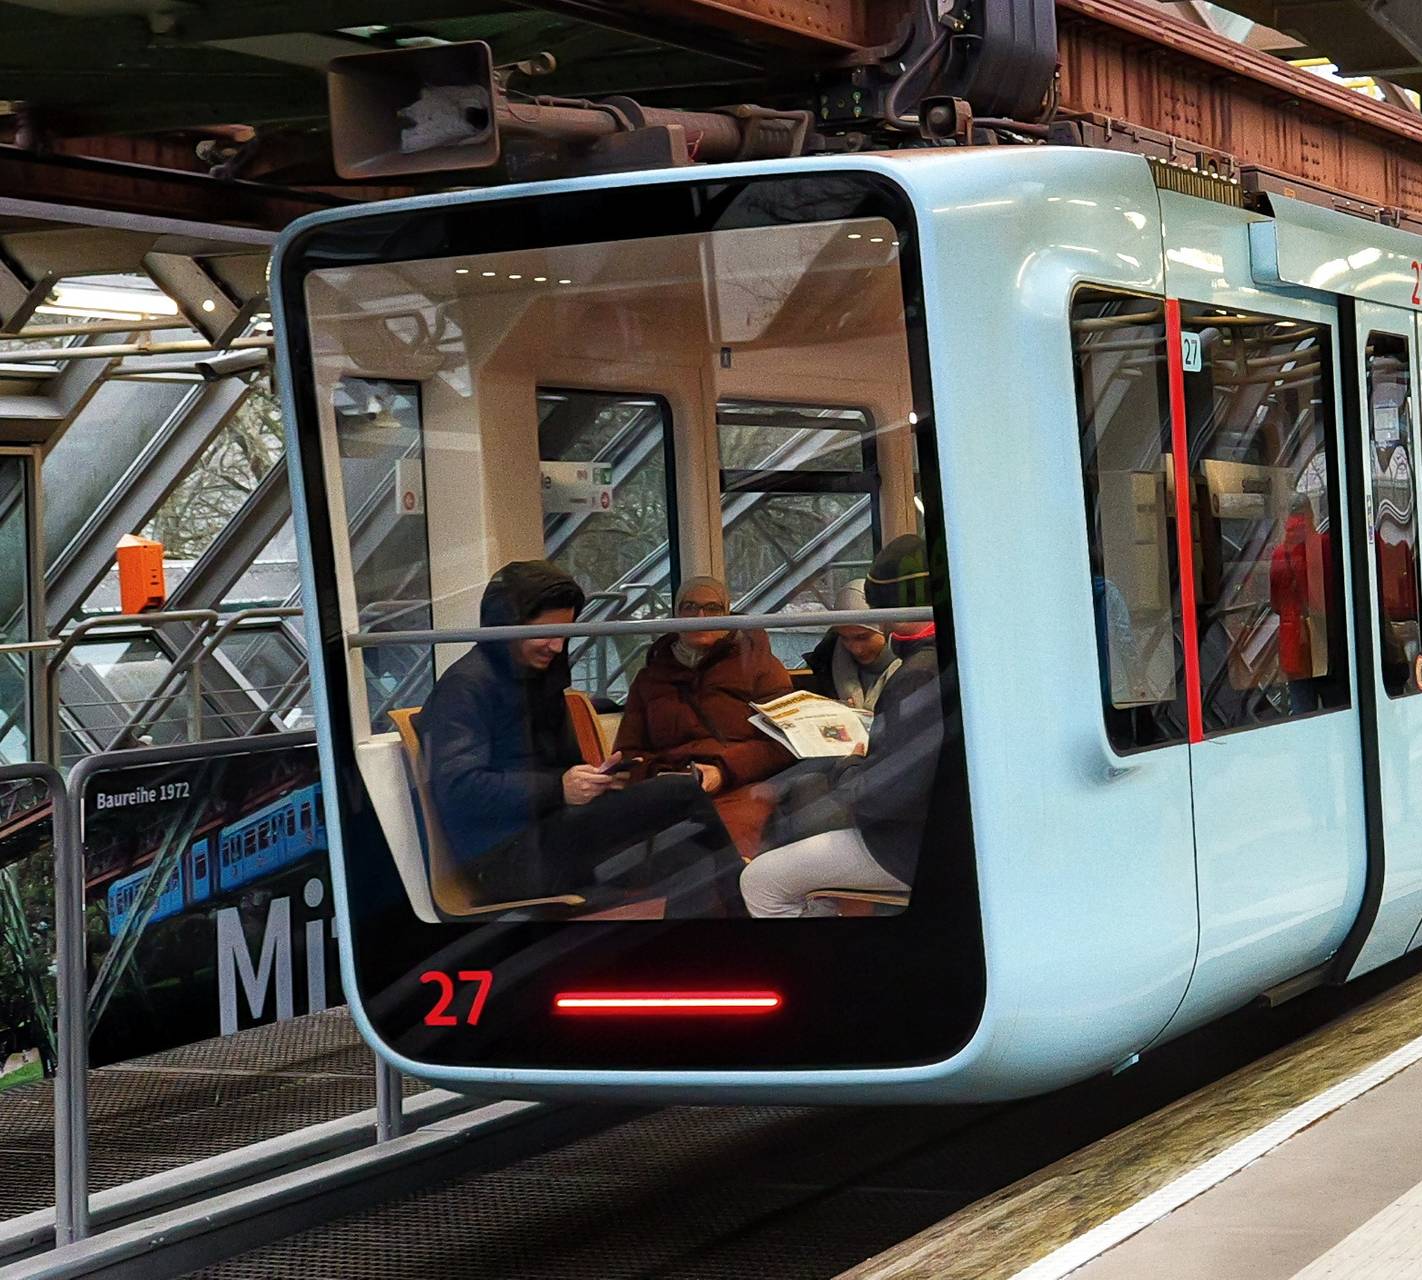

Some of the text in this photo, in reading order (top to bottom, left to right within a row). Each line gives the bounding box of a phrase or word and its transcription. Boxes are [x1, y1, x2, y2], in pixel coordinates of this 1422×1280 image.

[1183, 338, 1198, 365] 27
[96, 782, 190, 810] Baureihe 1972
[217, 877, 338, 1037] Mi
[420, 970, 493, 1026] 27
